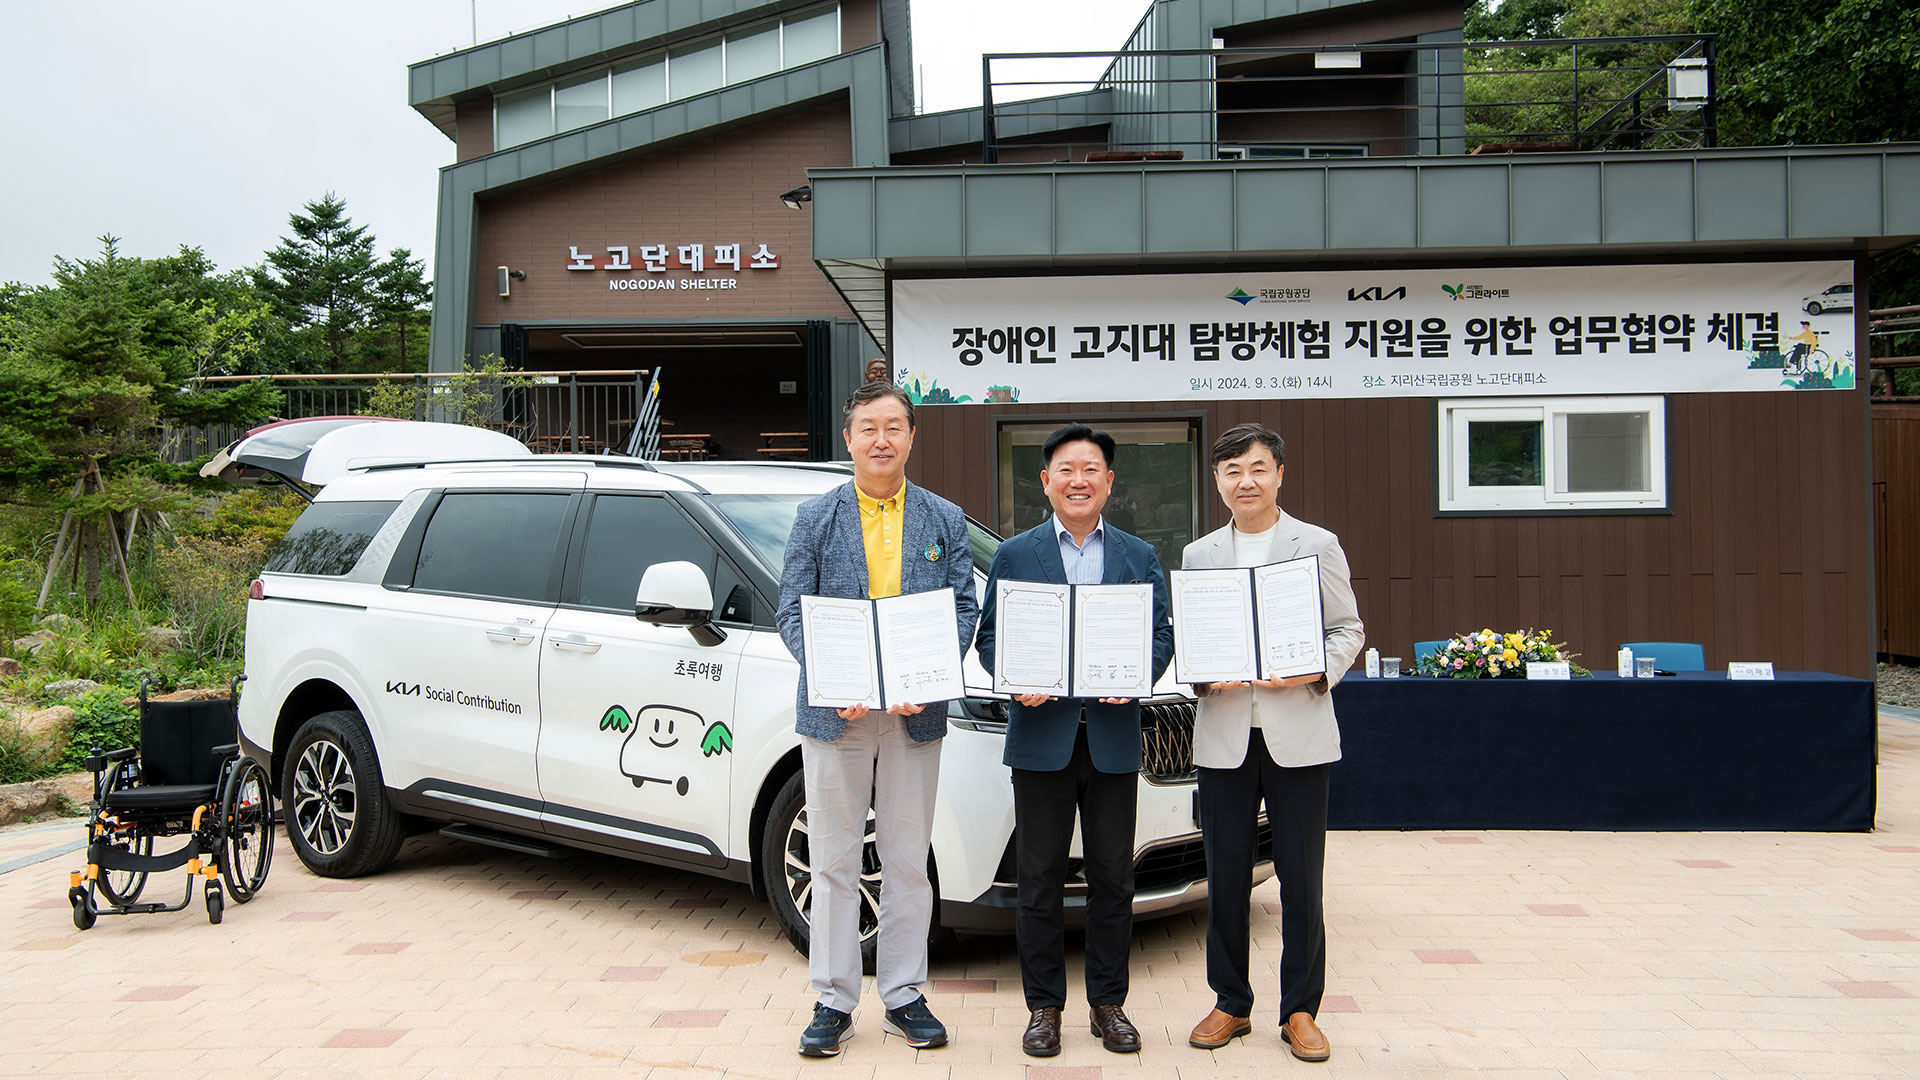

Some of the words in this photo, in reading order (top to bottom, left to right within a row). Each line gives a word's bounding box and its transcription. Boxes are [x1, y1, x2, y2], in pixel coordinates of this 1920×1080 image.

[567, 243, 778, 272] 노고단대피소
[609, 279, 675, 291] NOGODAN
[680, 278, 737, 290] SHELTER
[1260, 288, 1311, 299] 국립공원공단
[1347, 286, 1406, 301] KIA
[1466, 289, 1510, 299] 그린라이트
[952, 325, 1057, 366] 장애인
[1070, 323, 1176, 362] 고지대
[1189, 319, 1330, 362] 탐방체험
[1344, 317, 1452, 358] 지원을
[1464, 315, 1537, 356] 위한
[1548, 312, 1696, 355] 업무협약
[1707, 311, 1780, 352] 체결
[1189, 377, 1213, 391] 일시
[1217, 377, 1251, 390] 2024.
[1254, 377, 1266, 389] 9.
[1306, 375, 1333, 389] 14시
[1362, 375, 1386, 388] 장소
[1390, 373, 1473, 387] 지리산국립공원
[1476, 372, 1547, 386] 노고단대피소
[673, 659, 723, 682] 초록여행
[386, 680, 421, 697] KIA
[425, 685, 455, 703] Social
[456, 691, 522, 715] Contribution
